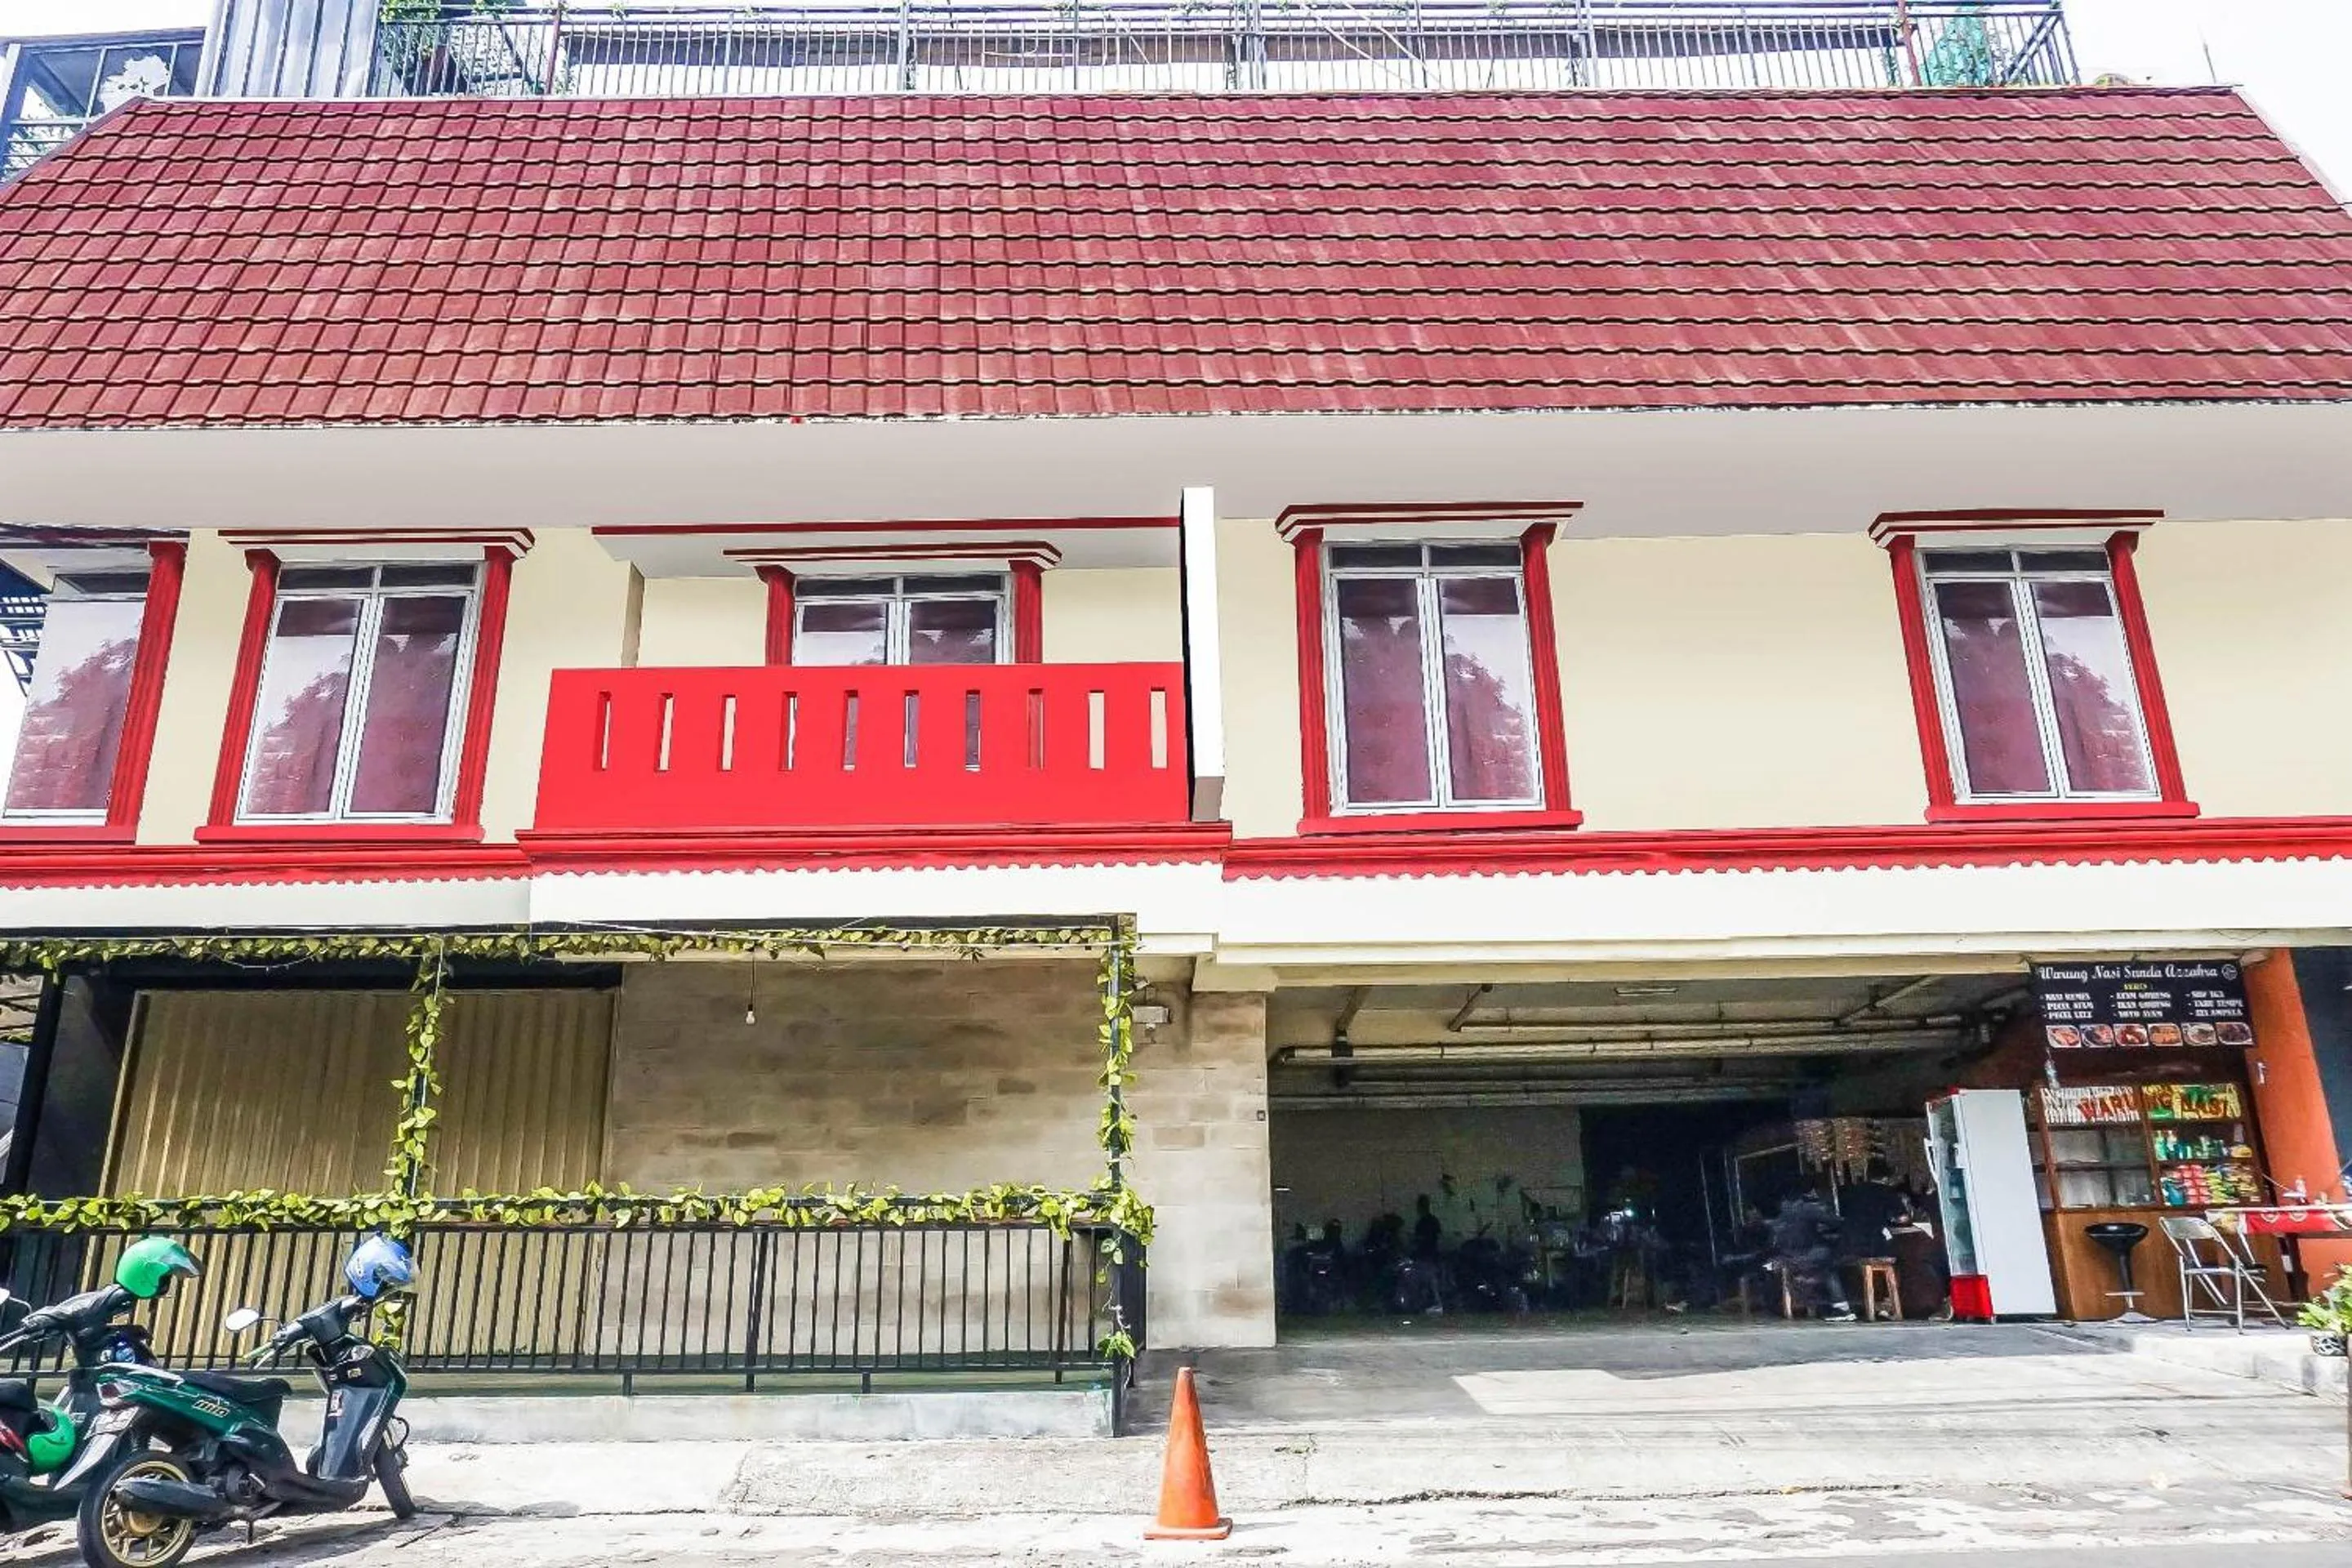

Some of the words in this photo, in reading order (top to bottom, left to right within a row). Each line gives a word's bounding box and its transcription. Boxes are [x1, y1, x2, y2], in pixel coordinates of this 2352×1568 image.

[2038, 966, 2088, 982] Warung
[2092, 965, 2121, 979] Nasi
[2124, 965, 2163, 978] Sunda
[2165, 964, 2218, 978] Azzahra
